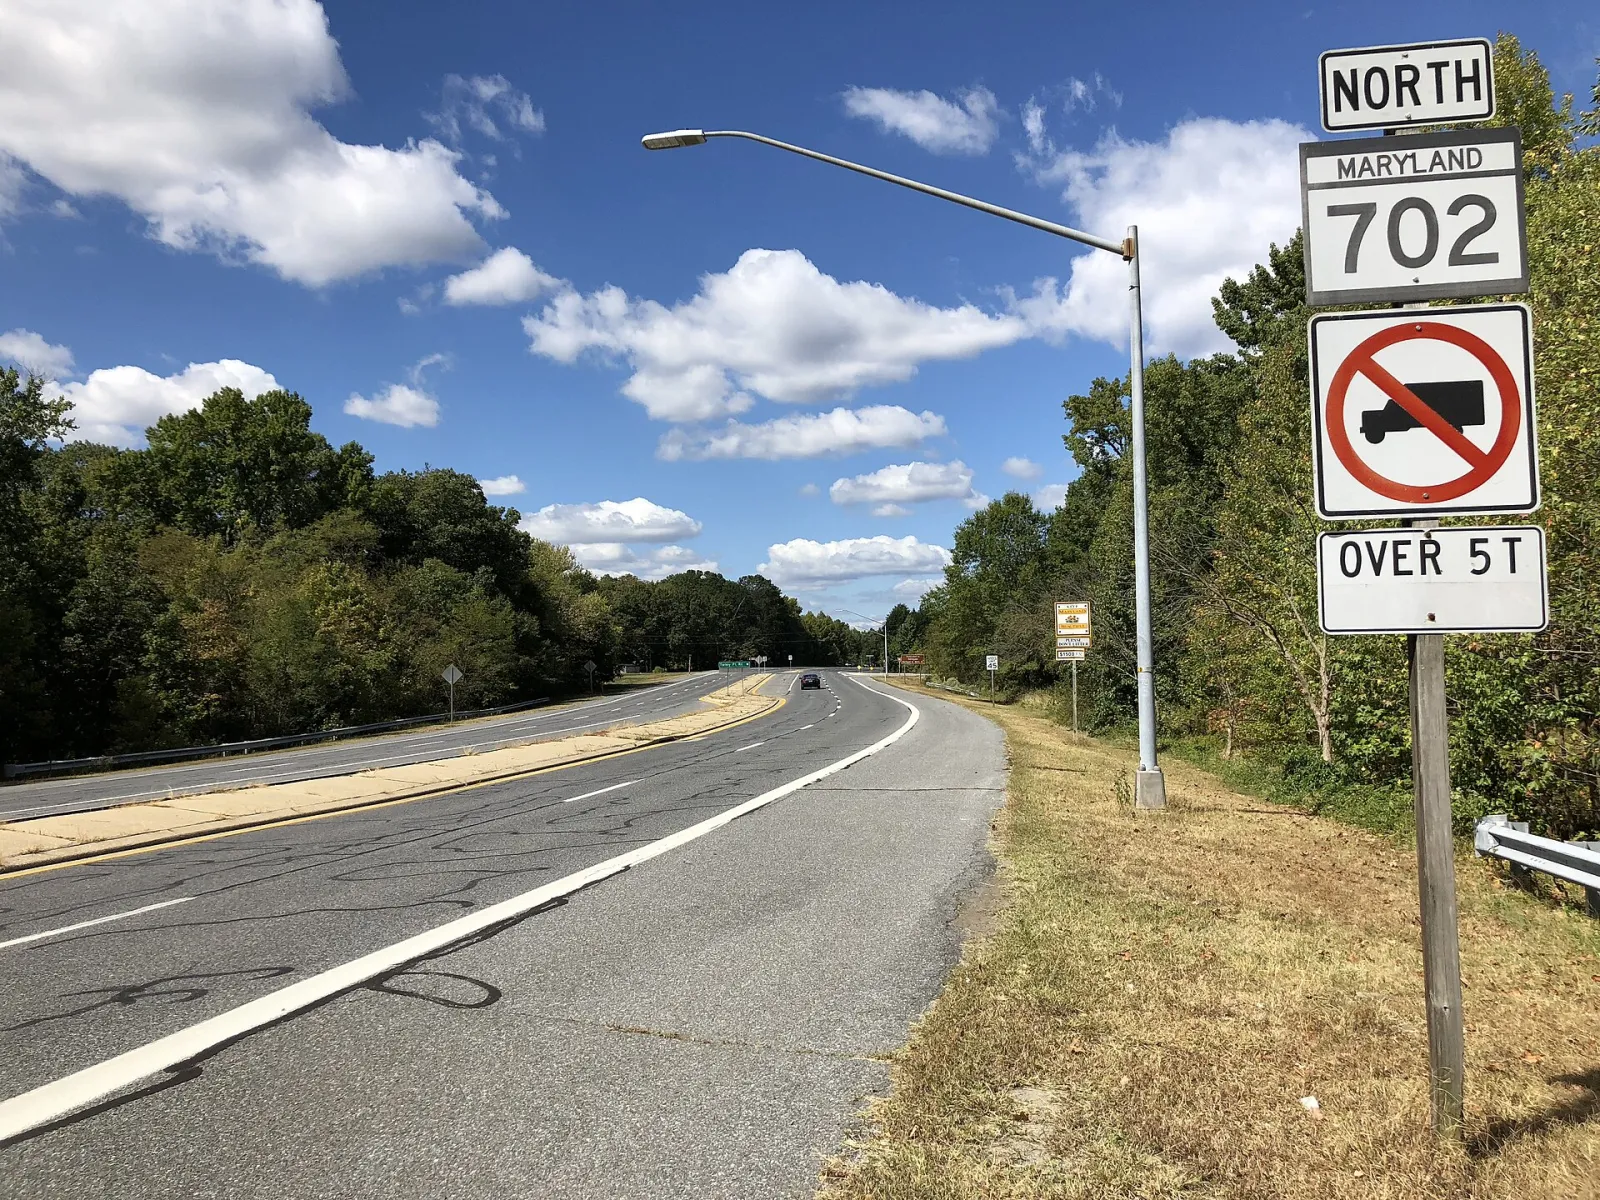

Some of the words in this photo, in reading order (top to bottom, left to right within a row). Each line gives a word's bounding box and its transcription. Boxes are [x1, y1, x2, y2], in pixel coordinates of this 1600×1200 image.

[1332, 58, 1482, 113] NORTH
[1337, 147, 1483, 179] MARYLAND
[1327, 194, 1500, 274] 702
[1339, 539, 1442, 578] OVER
